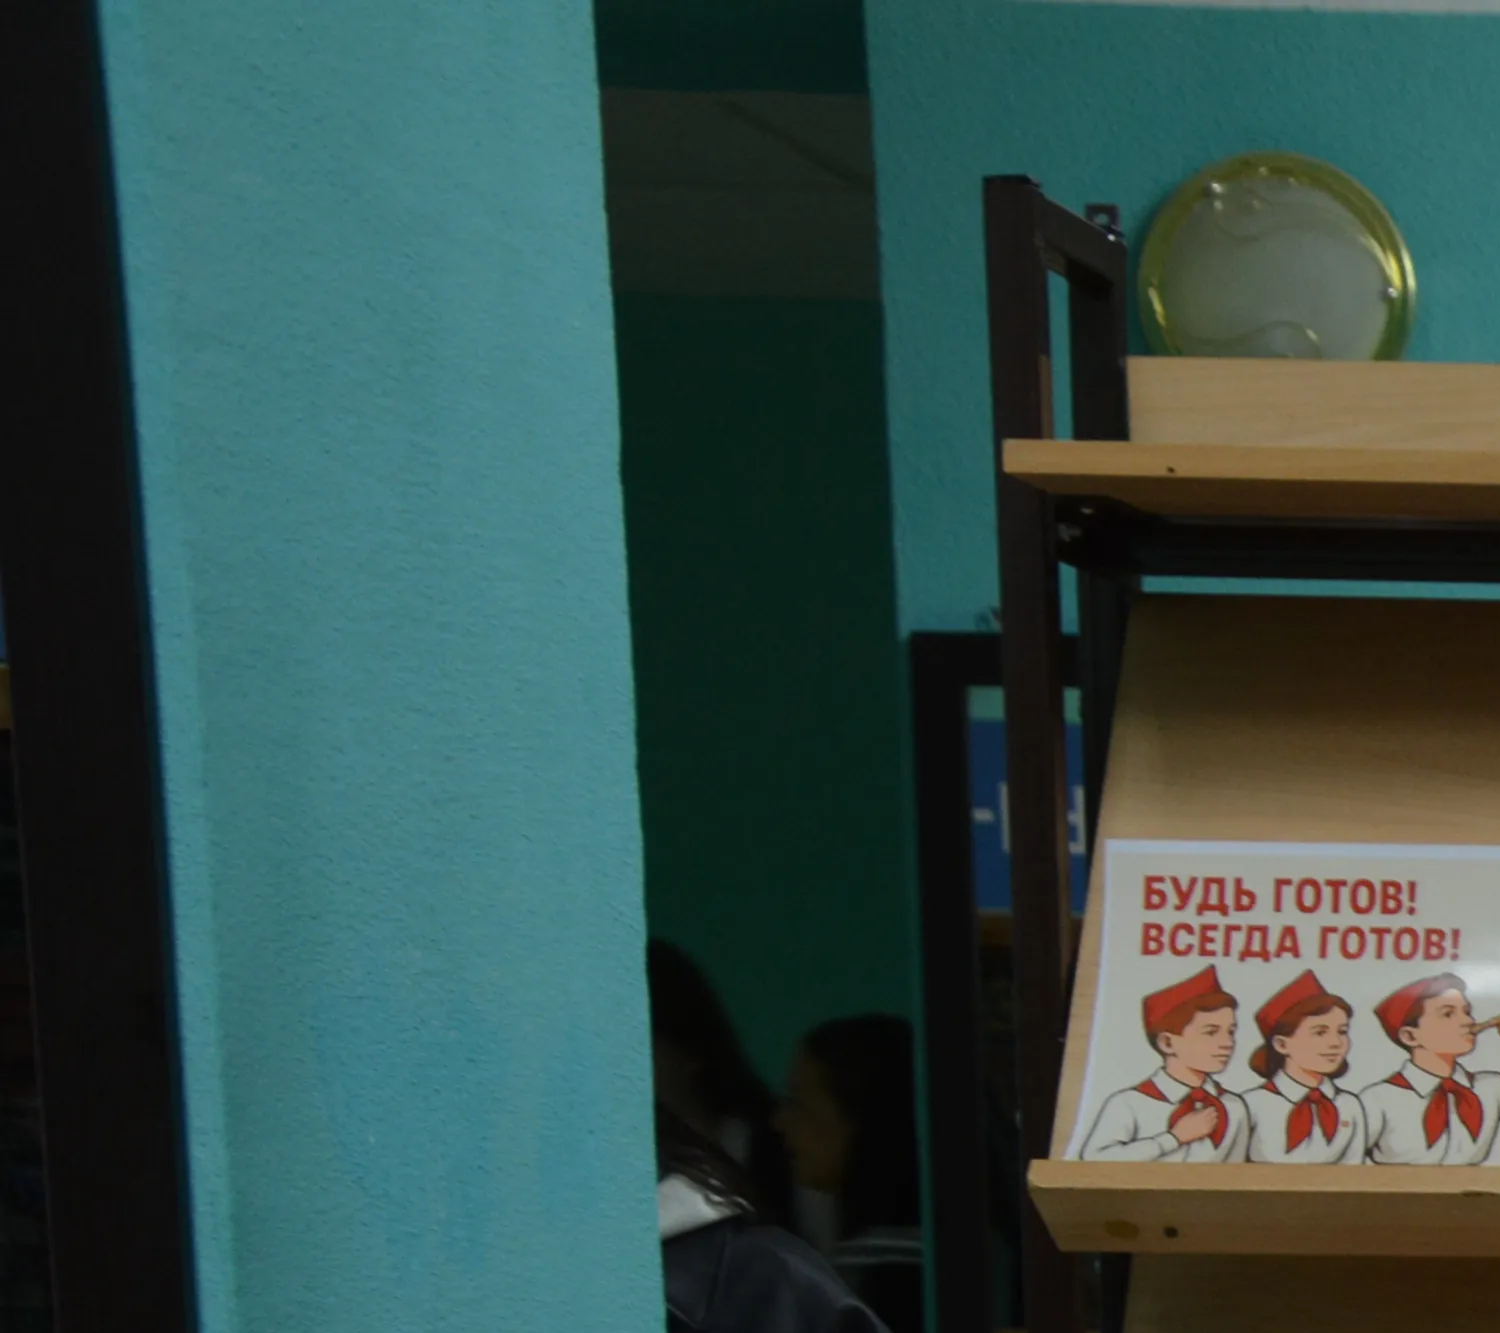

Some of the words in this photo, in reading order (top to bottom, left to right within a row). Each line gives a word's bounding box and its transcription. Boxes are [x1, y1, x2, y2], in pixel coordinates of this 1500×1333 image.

[1142, 873, 1257, 917] БУДЬ
[1271, 876, 1418, 916] ГОТОВ!
[1140, 922, 1301, 961] ВСЕГДА
[1316, 925, 1461, 963] ГОТОВ!
